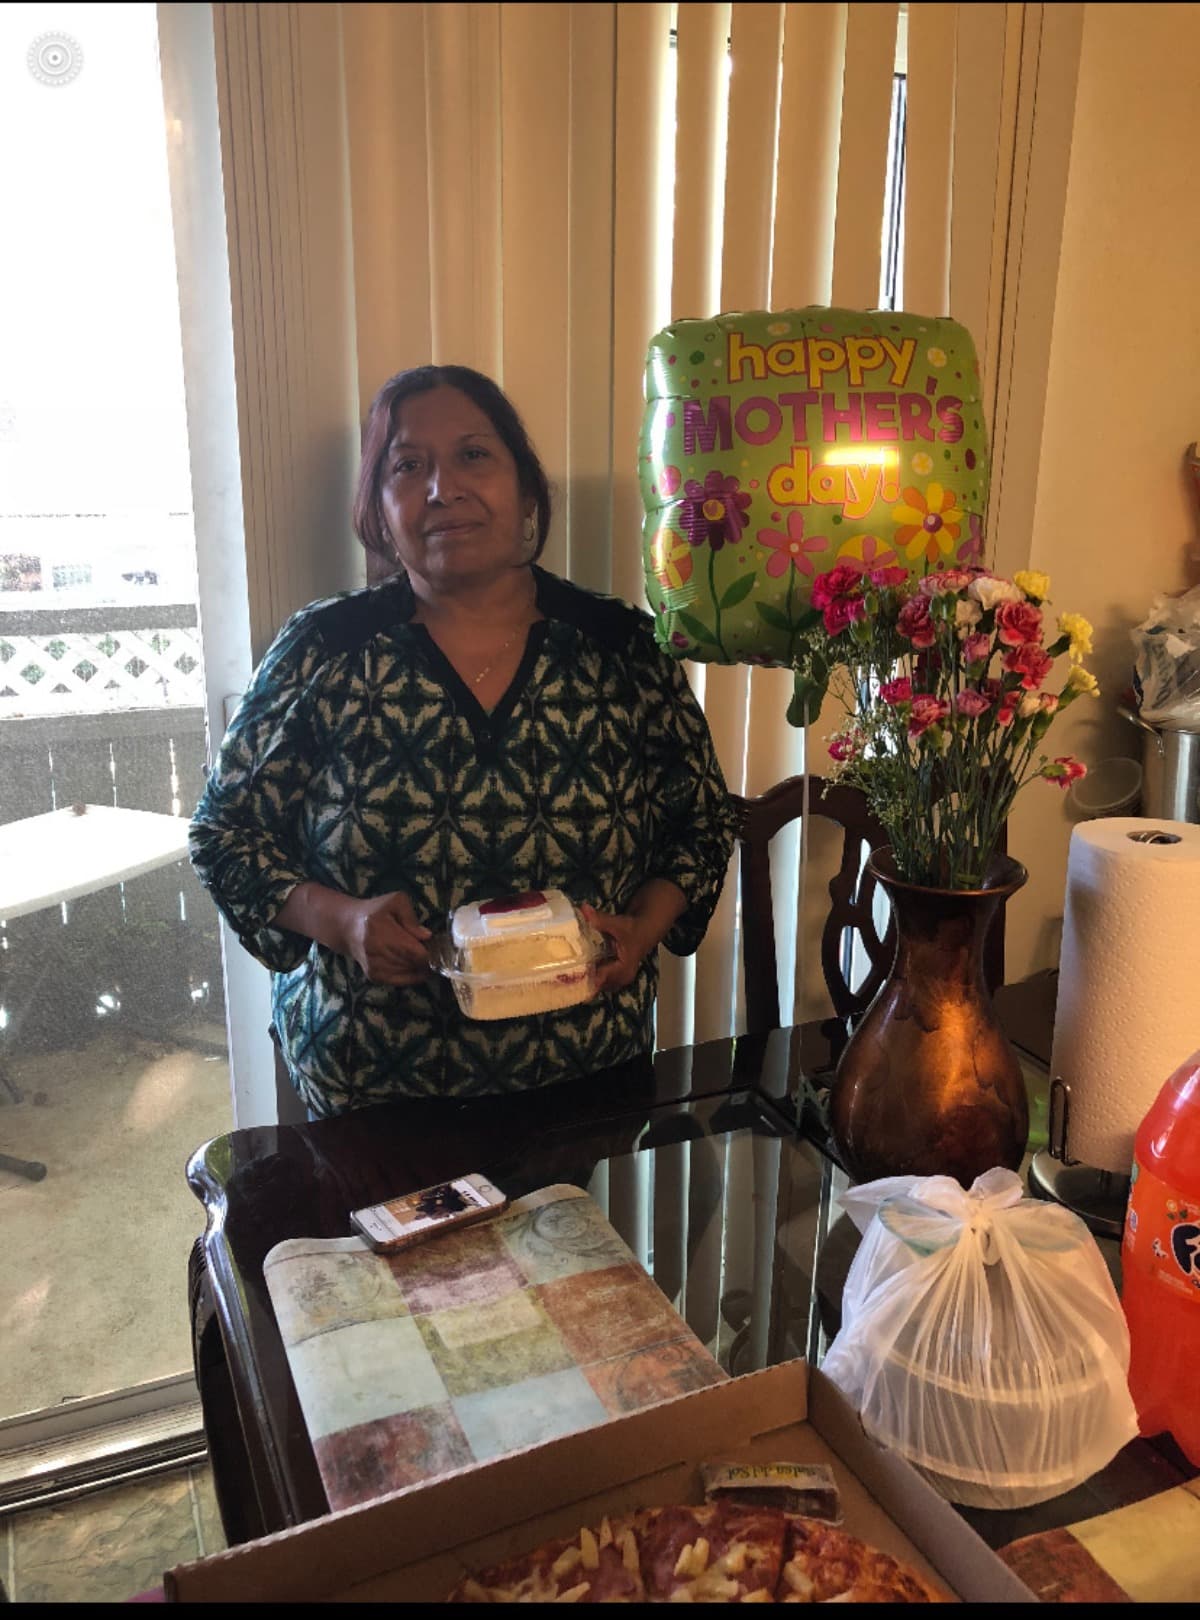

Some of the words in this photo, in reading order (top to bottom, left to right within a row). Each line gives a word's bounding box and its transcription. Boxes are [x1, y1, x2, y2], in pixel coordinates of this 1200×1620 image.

[727, 332, 918, 390] happy
[683, 376, 965, 456] MOTHER'S
[767, 446, 900, 519] day!
